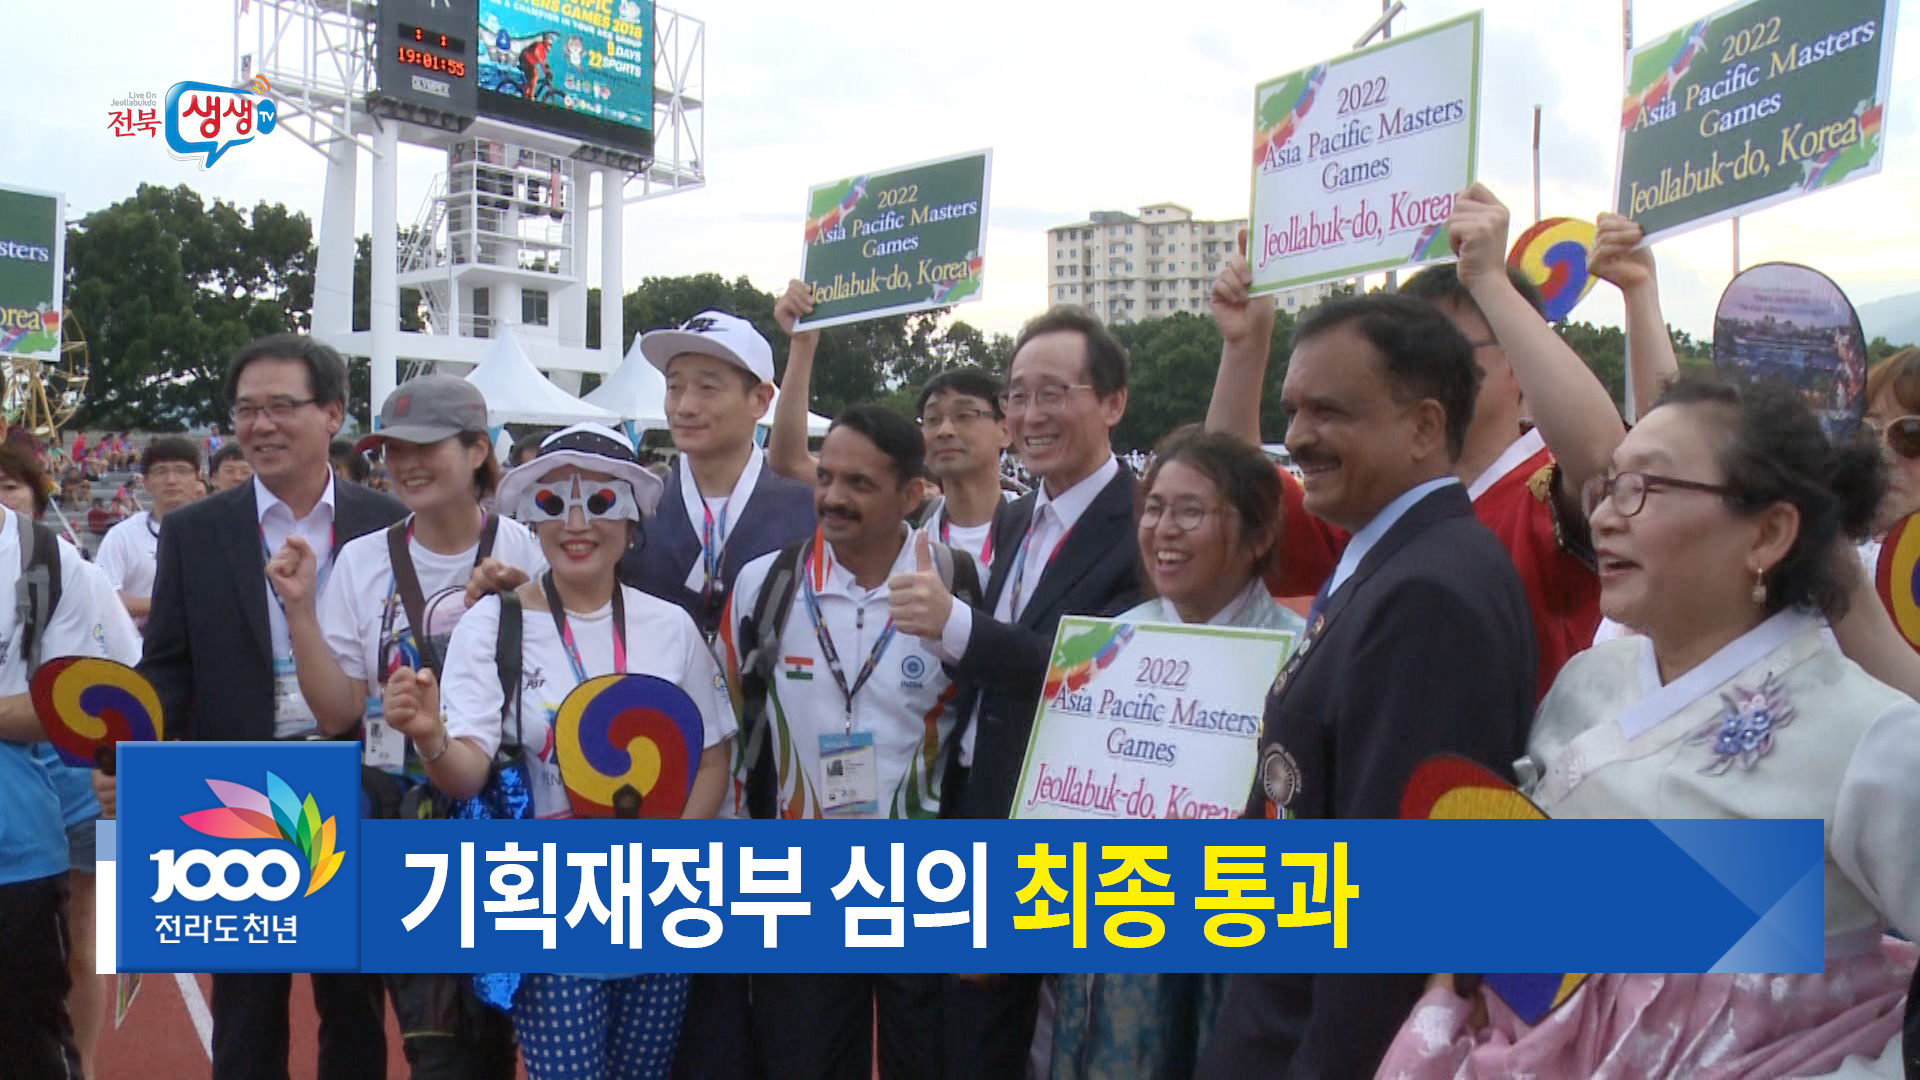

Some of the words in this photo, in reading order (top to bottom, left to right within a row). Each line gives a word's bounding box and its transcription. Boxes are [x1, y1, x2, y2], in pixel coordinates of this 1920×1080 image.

[562, 3, 611, 29] GAMES
[612, 18, 642, 39] 2018
[615, 45, 641, 62] DAYS
[1720, 16, 1781, 64] 2022
[399, 46, 464, 77] 19:01:55
[602, 56, 641, 77] SPORTS
[1632, 96, 1677, 133] Asia
[1684, 62, 1760, 113] Pacific
[1768, 20, 1876, 80] Masters
[1337, 75, 1387, 116] 2022
[1700, 92, 1782, 138] Games
[1263, 139, 1301, 171] Asia
[1308, 118, 1372, 159] Pacific
[1377, 98, 1464, 140] Masters
[1322, 156, 1390, 190] Games
[1629, 139, 1771, 220] Jeollabuk-do,
[1777, 116, 1857, 167] Korea
[877, 184, 918, 209] 2022
[814, 224, 846, 245] Asia
[852, 211, 904, 238] Pacific
[909, 199, 977, 226] Masters
[1258, 200, 1383, 268] Jeollabuk-do,
[1389, 191, 1452, 231] Korea
[862, 234, 919, 258] Games
[917, 259, 968, 285] Korea
[1135, 657, 1190, 686] 2022
[1051, 687, 1092, 712] Asia
[1099, 689, 1166, 722] Pacific
[1169, 697, 1258, 734] Masters
[1107, 727, 1176, 763] Games
[1164, 785, 1228, 819] Korea
